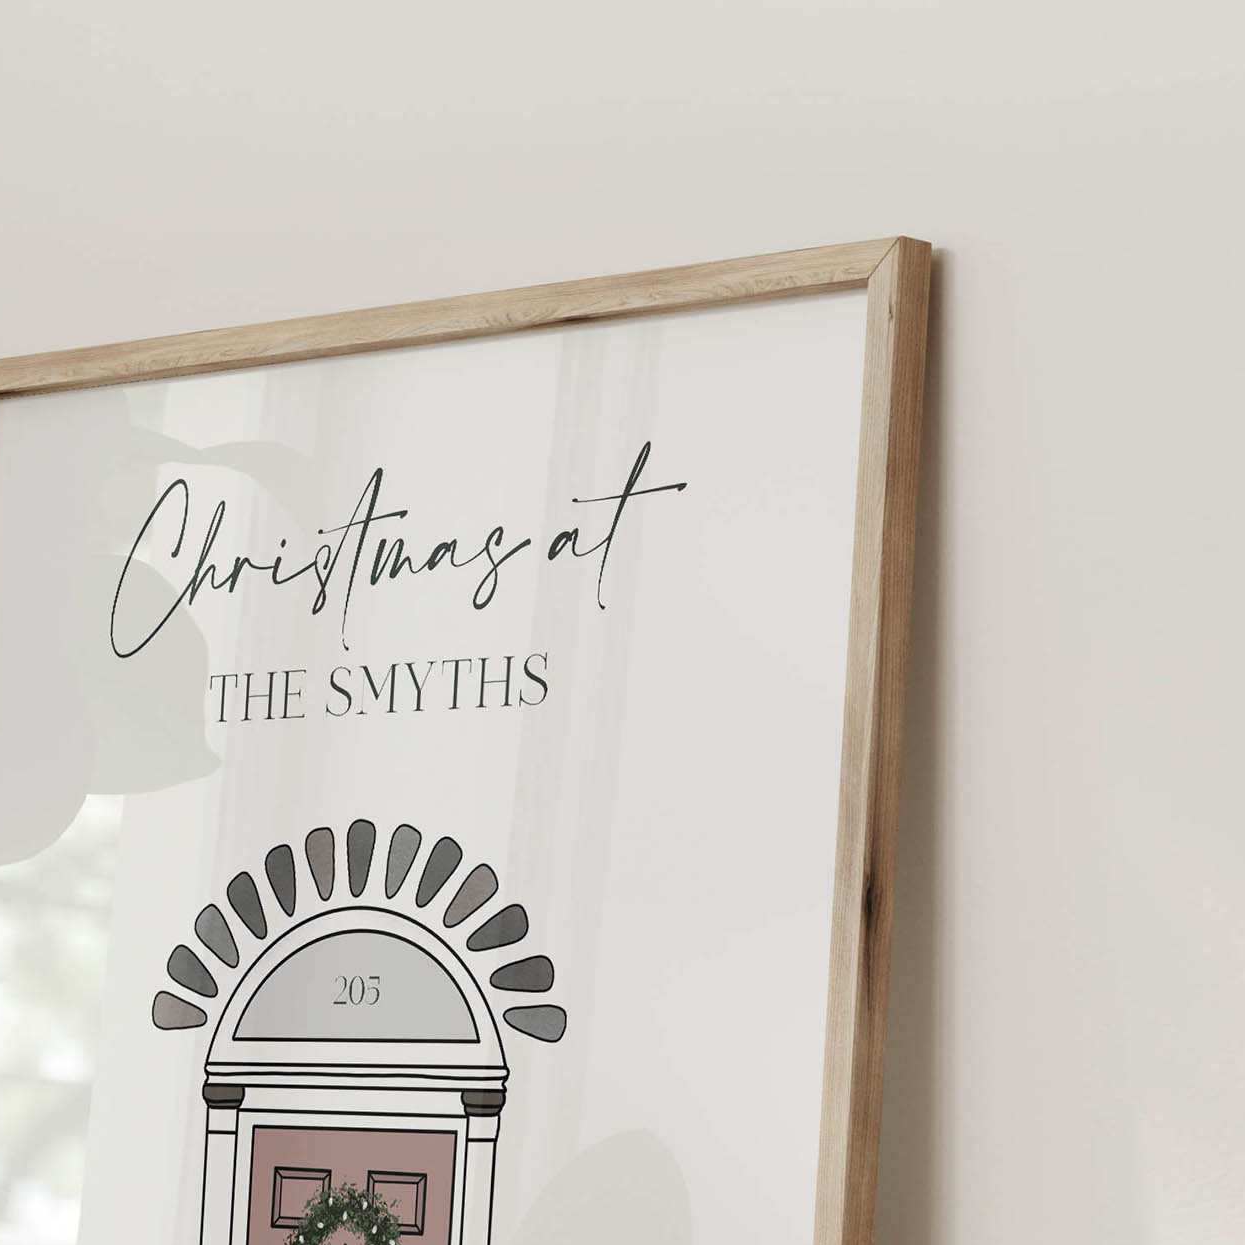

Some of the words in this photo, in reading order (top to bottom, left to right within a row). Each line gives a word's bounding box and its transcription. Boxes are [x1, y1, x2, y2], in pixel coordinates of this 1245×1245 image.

[111, 467, 530, 658] Christmas
[548, 440, 687, 610] at
[210, 669, 307, 722] THE
[326, 652, 548, 717] SMYTHS
[333, 975, 380, 1006] 205
